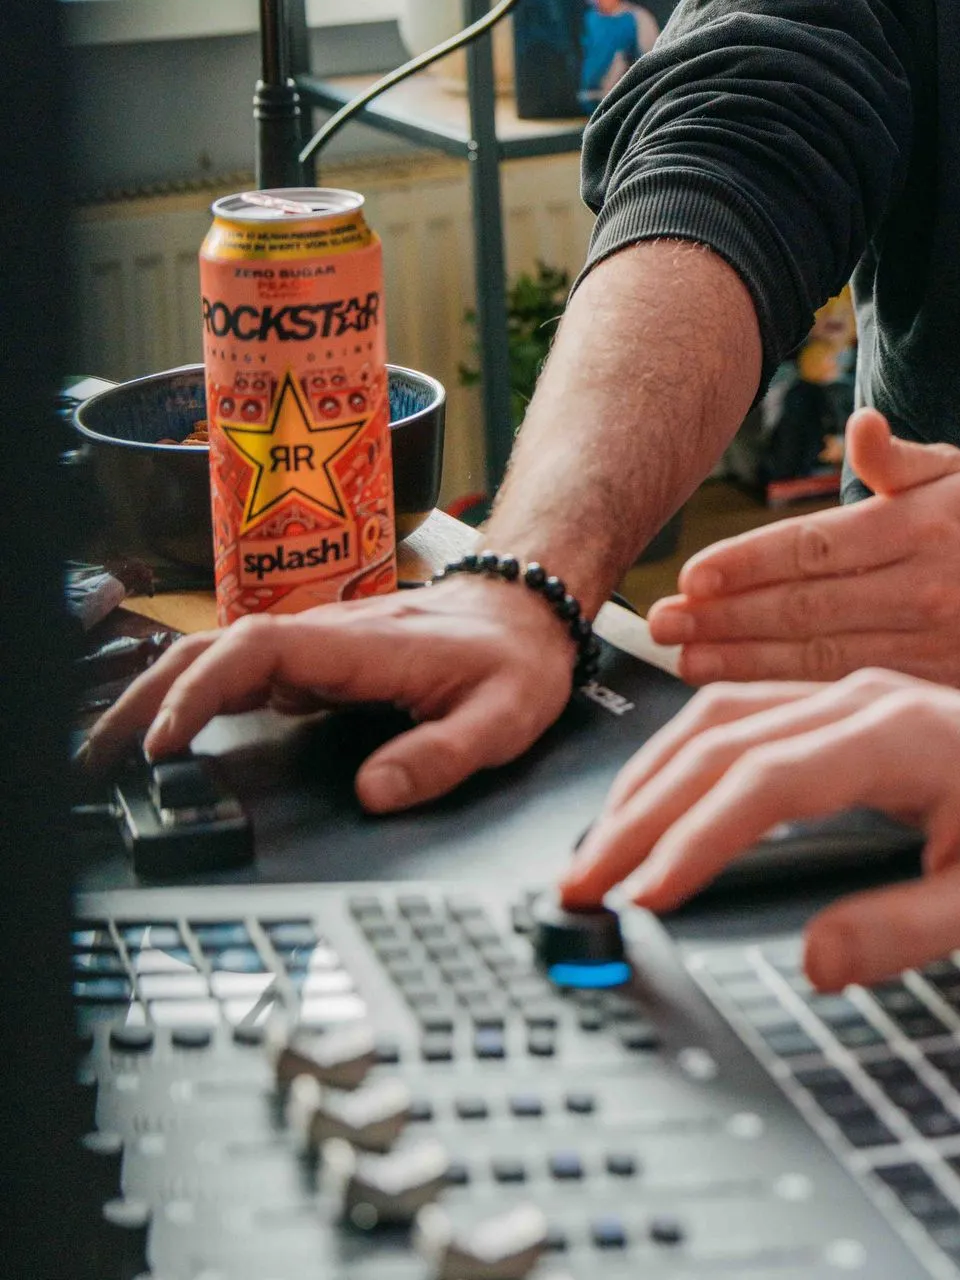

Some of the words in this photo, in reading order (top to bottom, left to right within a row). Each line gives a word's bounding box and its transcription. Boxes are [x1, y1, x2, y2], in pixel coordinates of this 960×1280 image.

[234, 267, 274, 279] ZERO
[279, 264, 335, 279] SUGAR
[243, 532, 350, 581] splash!
